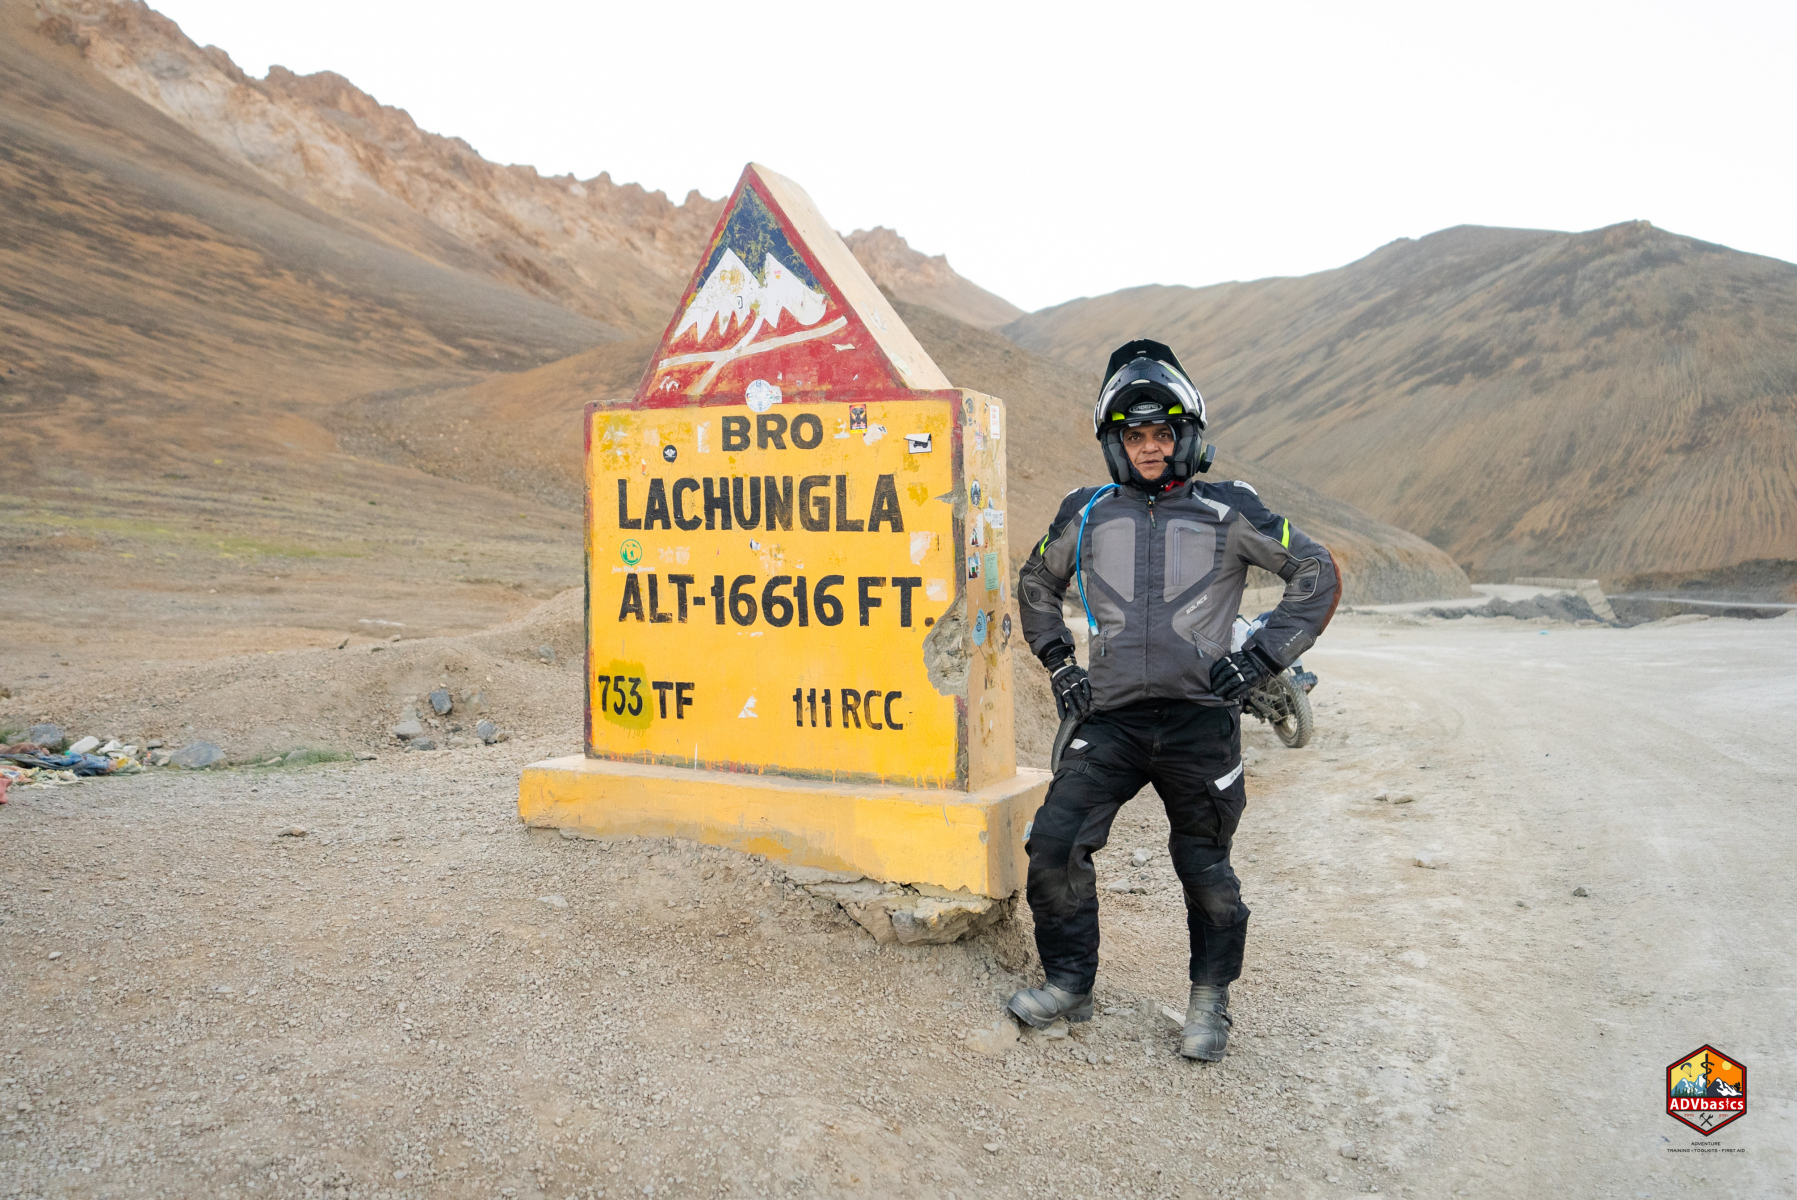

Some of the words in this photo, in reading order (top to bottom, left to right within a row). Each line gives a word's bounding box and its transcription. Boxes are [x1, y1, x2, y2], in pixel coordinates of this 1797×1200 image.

[721, 413, 824, 452] BRO
[617, 474, 904, 533] LACHUNGLA
[618, 573, 845, 627] ALT-16616
[858, 576, 937, 628] FT.
[598, 675, 643, 717] 753
[652, 681, 695, 720] TF
[793, 688, 833, 728] 111
[841, 688, 904, 731] RCC
